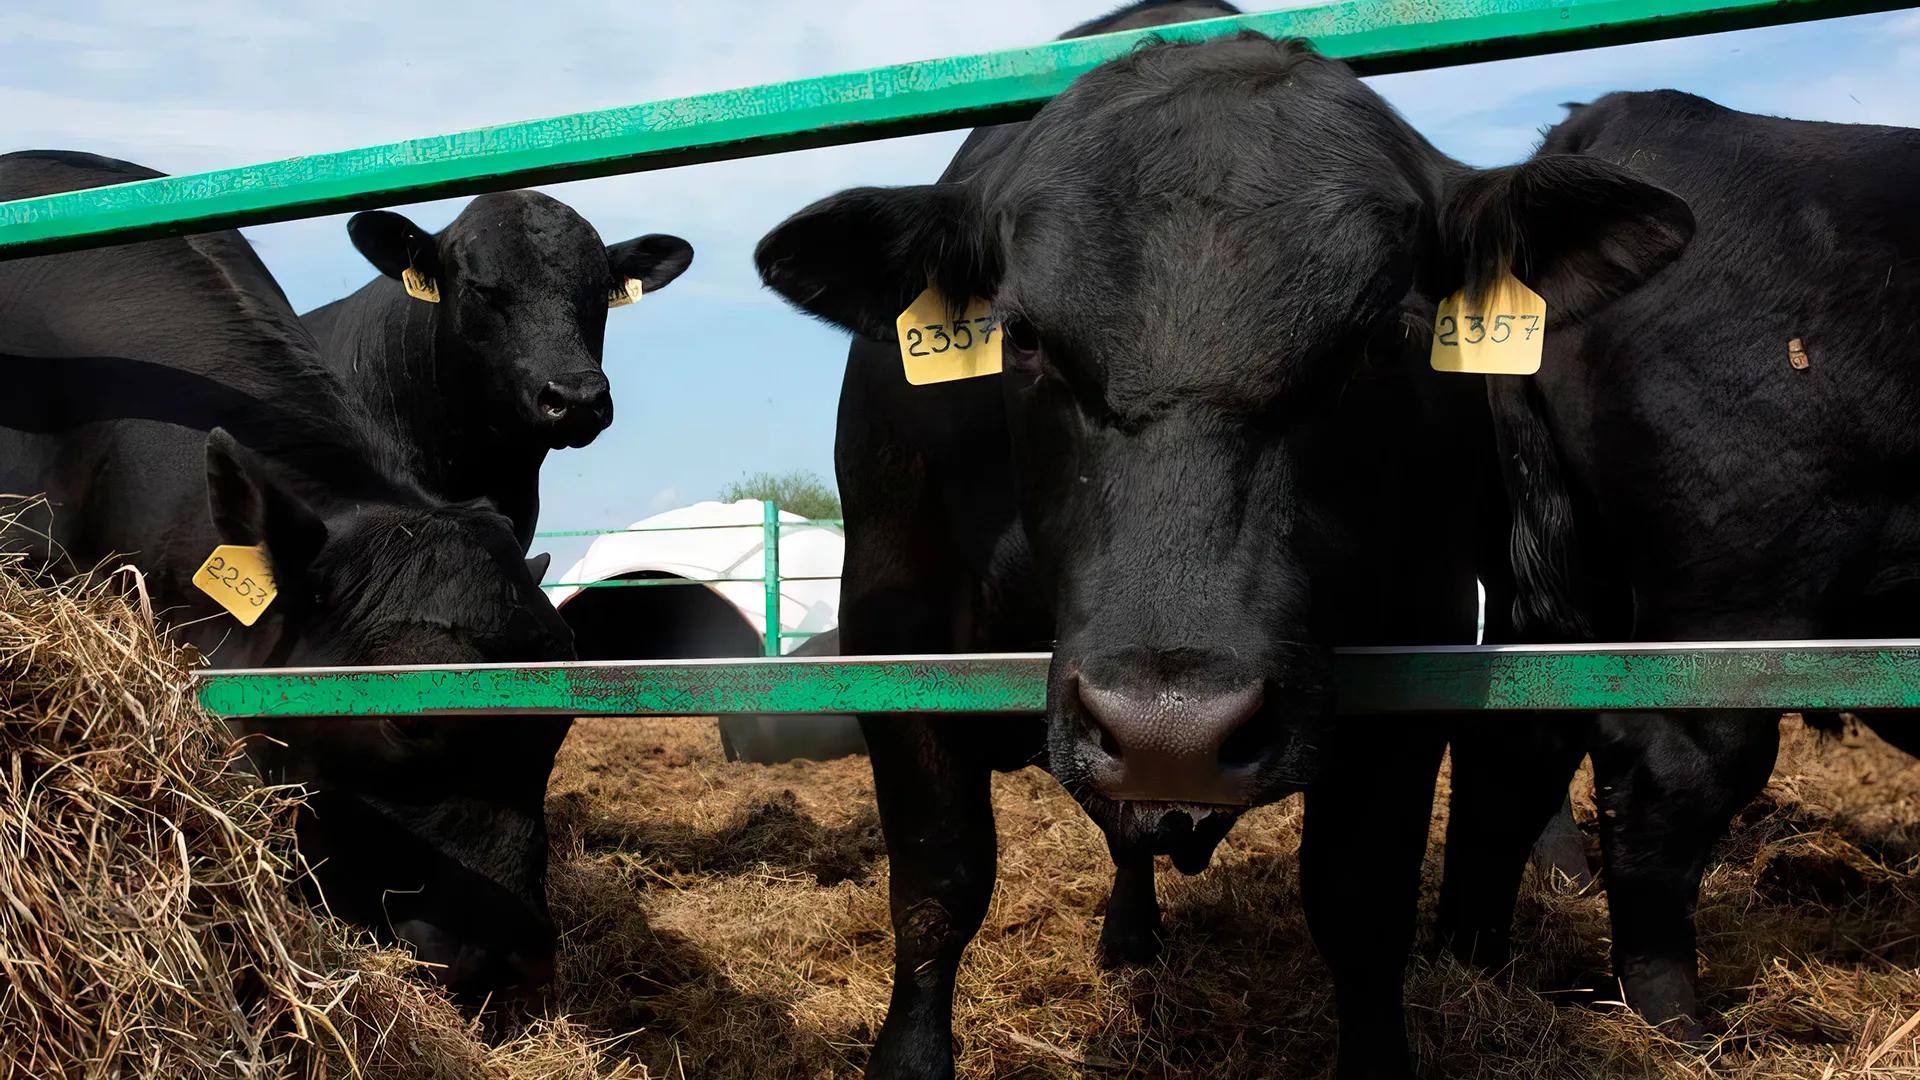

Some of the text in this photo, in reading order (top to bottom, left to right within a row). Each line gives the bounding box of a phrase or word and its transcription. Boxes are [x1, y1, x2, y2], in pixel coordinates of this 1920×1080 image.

[906, 317, 997, 357] 2357
[1438, 314, 1540, 346] 2357
[206, 556, 268, 607] 2253
